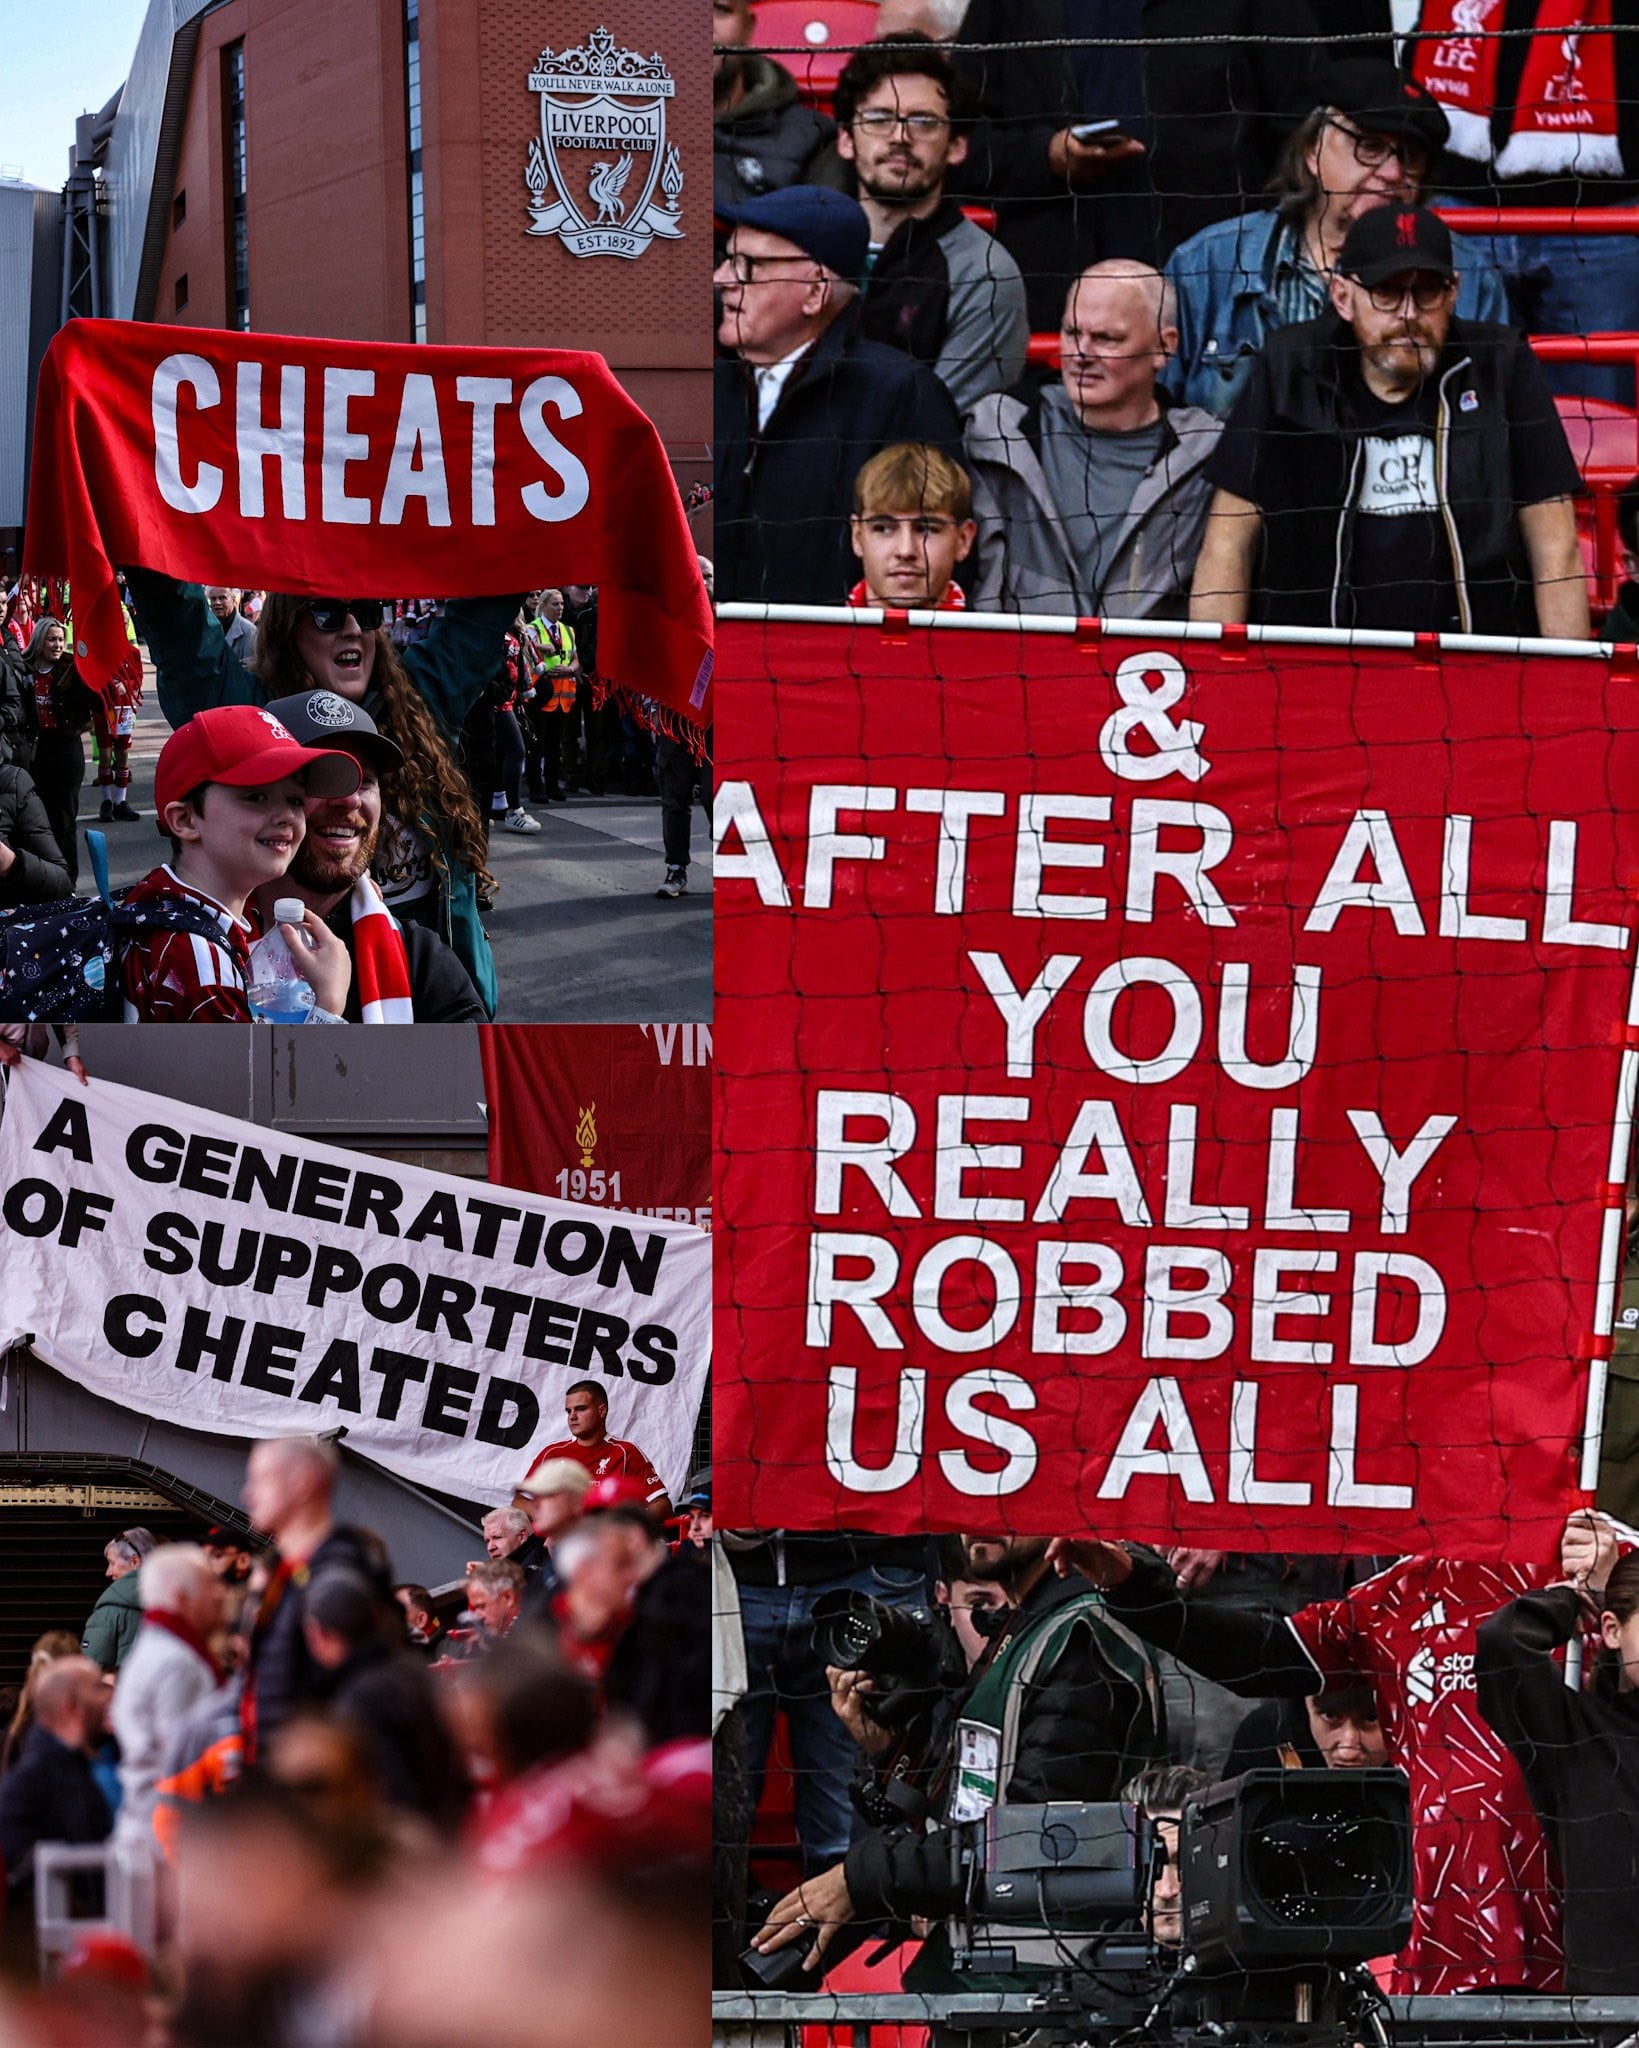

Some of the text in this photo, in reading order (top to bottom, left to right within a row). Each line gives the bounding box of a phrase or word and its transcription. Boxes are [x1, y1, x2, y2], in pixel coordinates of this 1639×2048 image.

[532, 77, 672, 93] YOU'LL NEVER WALK ALONE
[552, 114, 657, 136] LIVERPOOL
[556, 136, 654, 150] FOOTBALL CLUB
[1535, 109, 1594, 126] YNWA
[151, 353, 590, 527] CHEATS
[1099, 651, 1211, 783] &
[713, 780, 1630, 951] AFTER ALL
[967, 950, 1322, 1090] YOU
[33, 1097, 667, 1297] A GENERATION
[555, 1168, 621, 1202] 1951
[814, 1090, 1458, 1234] REALLY
[2, 1177, 678, 1386] OF SUPPORTERS
[805, 1232, 1447, 1367] ROBBED
[103, 1293, 540, 1450] CHEATED
[825, 1366, 1414, 1509] US ALL
[1443, 1652, 1475, 1672] sta
